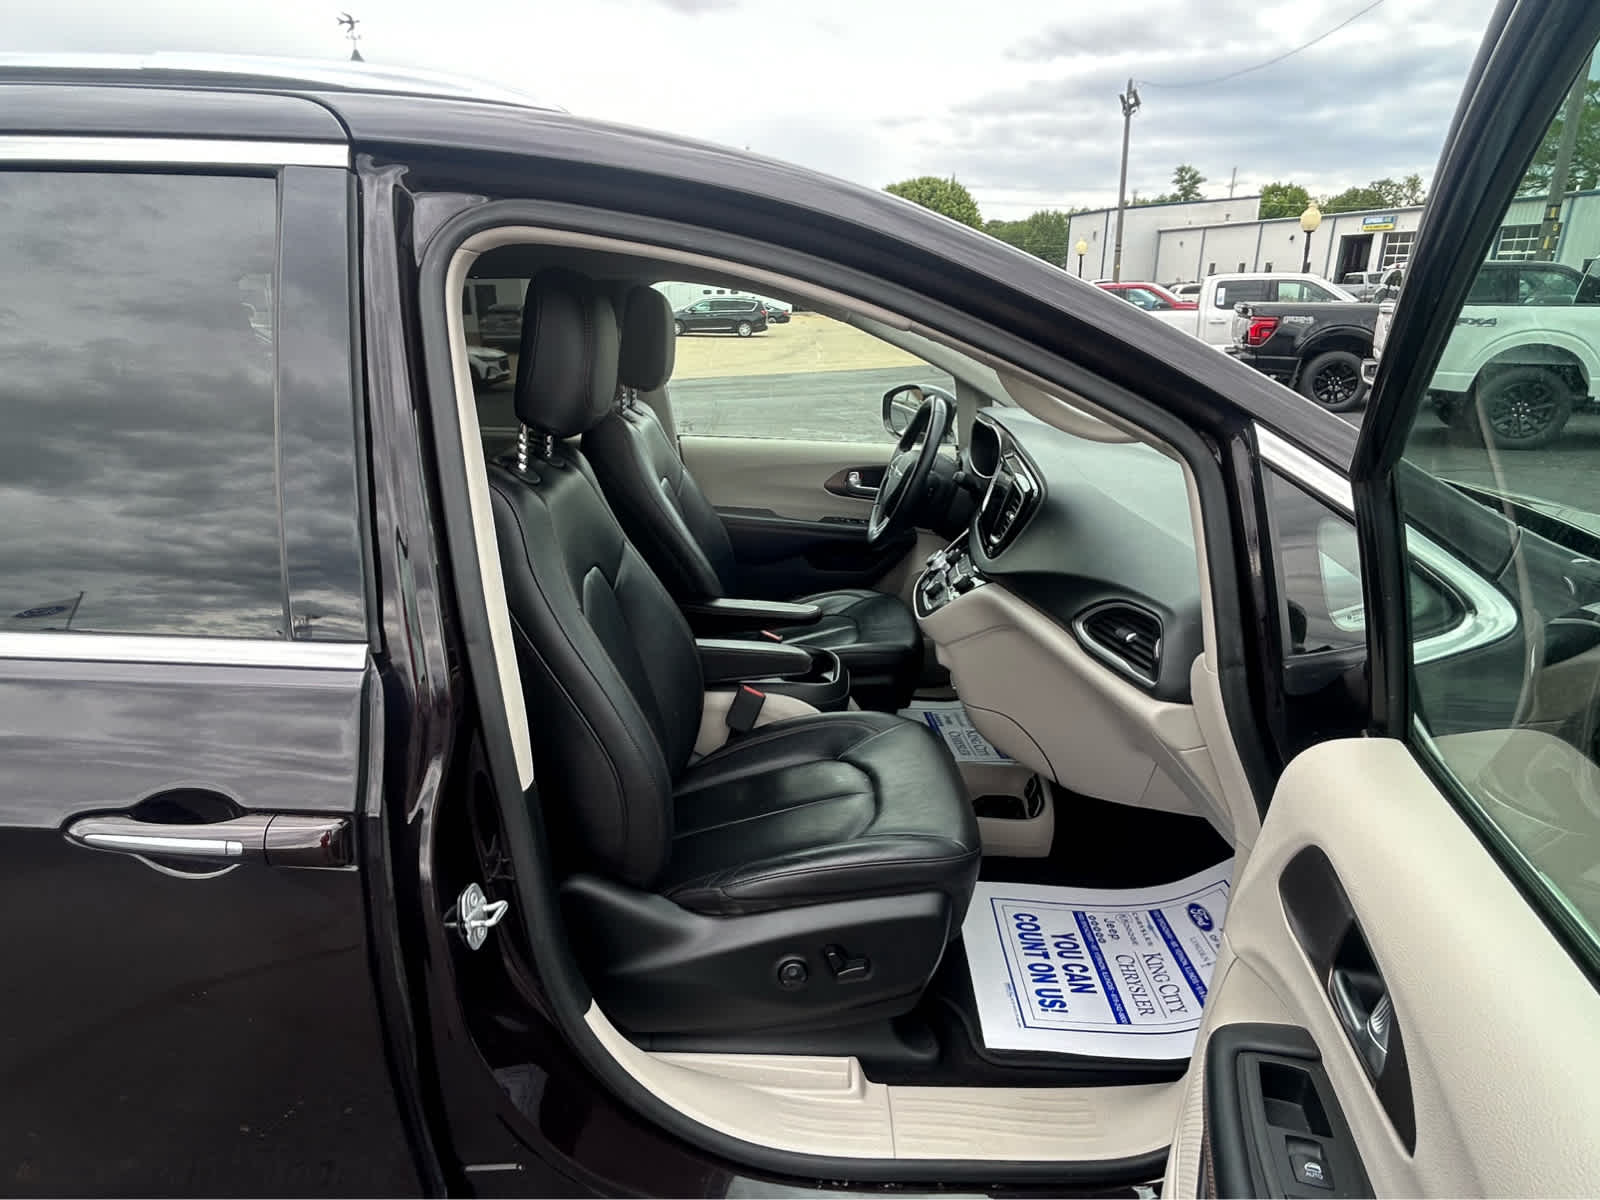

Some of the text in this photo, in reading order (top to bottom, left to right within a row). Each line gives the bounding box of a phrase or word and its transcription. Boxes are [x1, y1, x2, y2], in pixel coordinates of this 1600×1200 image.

[1103, 918, 1120, 941] Jeep
[1189, 905, 1212, 930] Ford
[1013, 913, 1050, 960] COUNT
[1050, 932, 1084, 960] YOU
[1027, 963, 1059, 984] ON
[1062, 963, 1098, 994] CAN
[1115, 954, 1156, 1016] CHRYSLER
[1142, 952, 1170, 983] KING
[1159, 984, 1188, 1013] CITY
[1034, 988, 1069, 1013] US!
